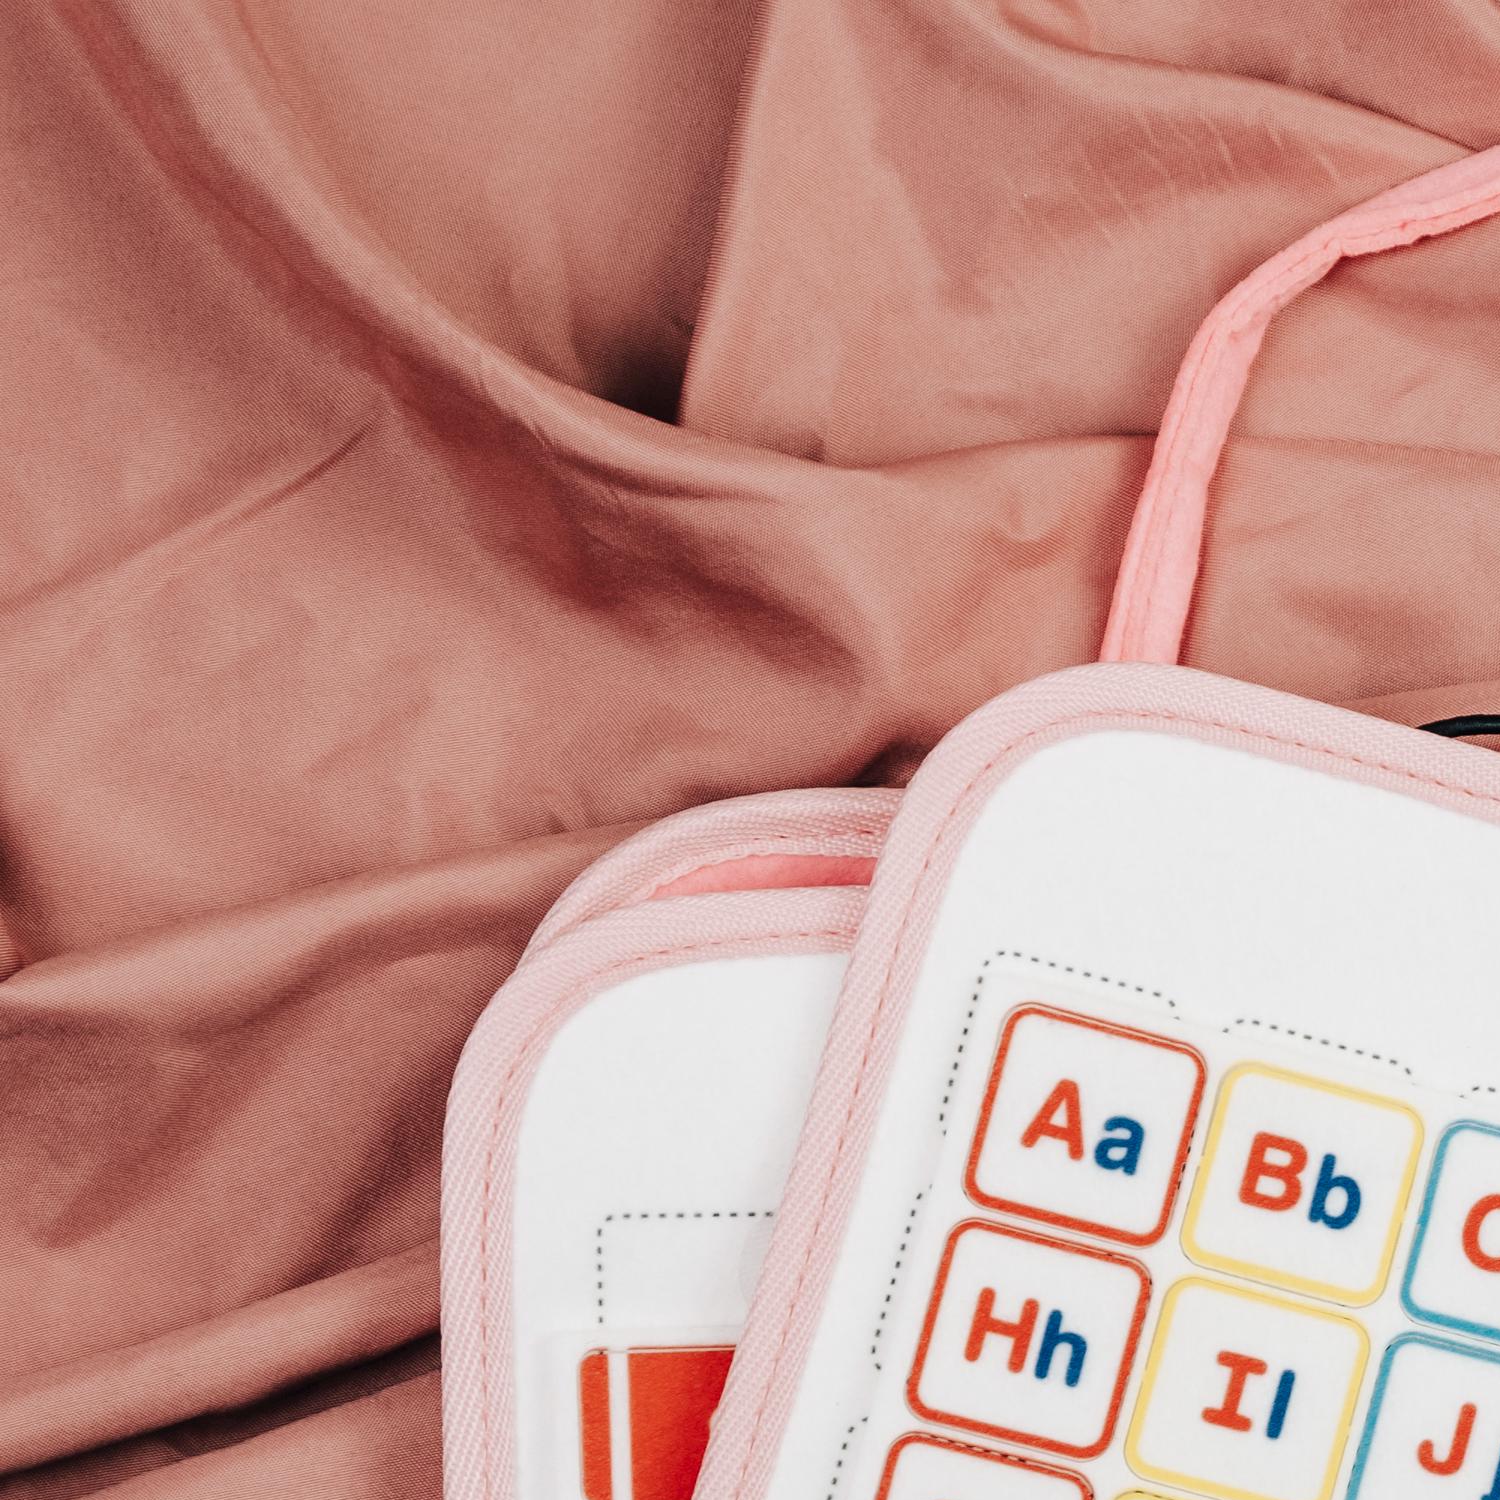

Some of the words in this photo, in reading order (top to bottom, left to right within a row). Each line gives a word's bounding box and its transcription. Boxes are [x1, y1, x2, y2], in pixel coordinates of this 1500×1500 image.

[1021, 1079, 1144, 1175] Aa
[1239, 1132, 1361, 1230] Bb
[964, 1288, 1087, 1387] Hh
